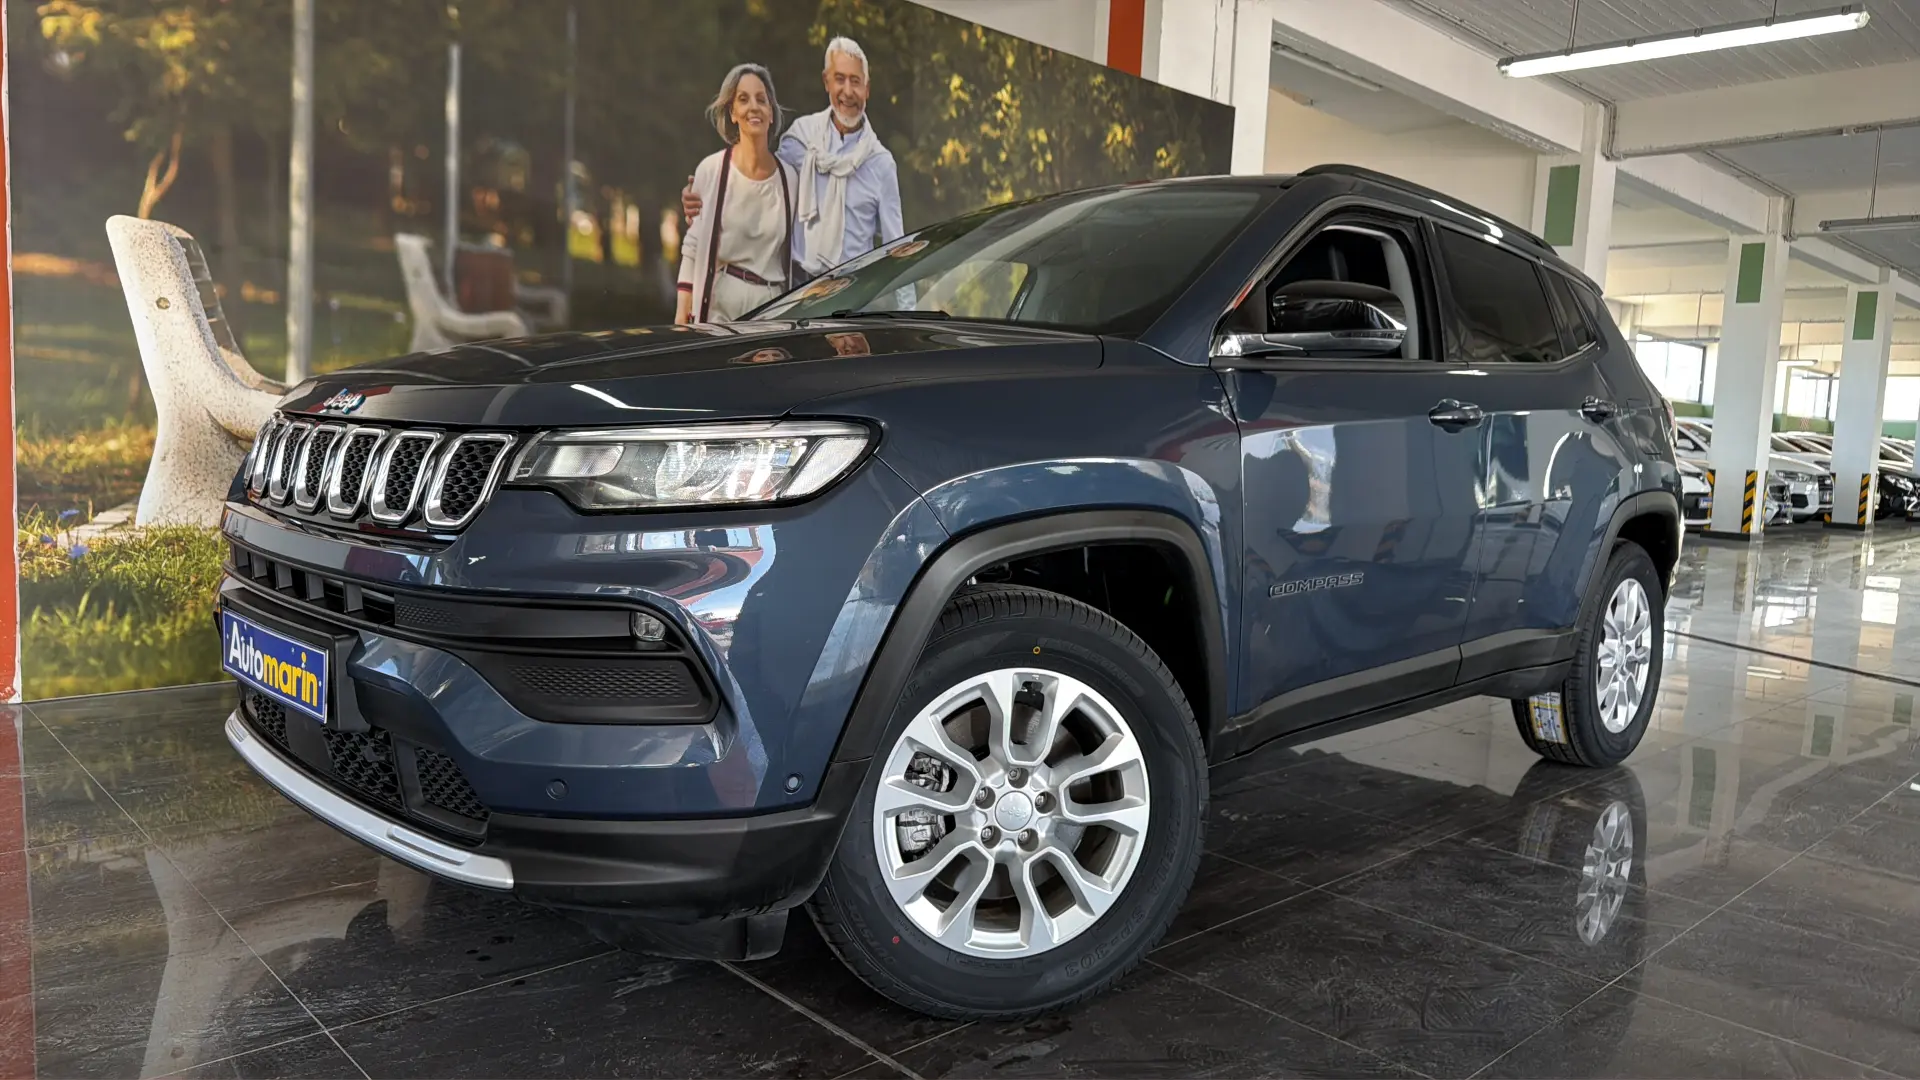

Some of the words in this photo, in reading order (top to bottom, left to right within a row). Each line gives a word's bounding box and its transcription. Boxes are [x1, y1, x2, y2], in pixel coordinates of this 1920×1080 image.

[323, 388, 367, 415] Jeep
[1268, 572, 1364, 598] COMPASS
[229, 621, 318, 707] Automarin
[1064, 904, 1147, 979] SP-303
